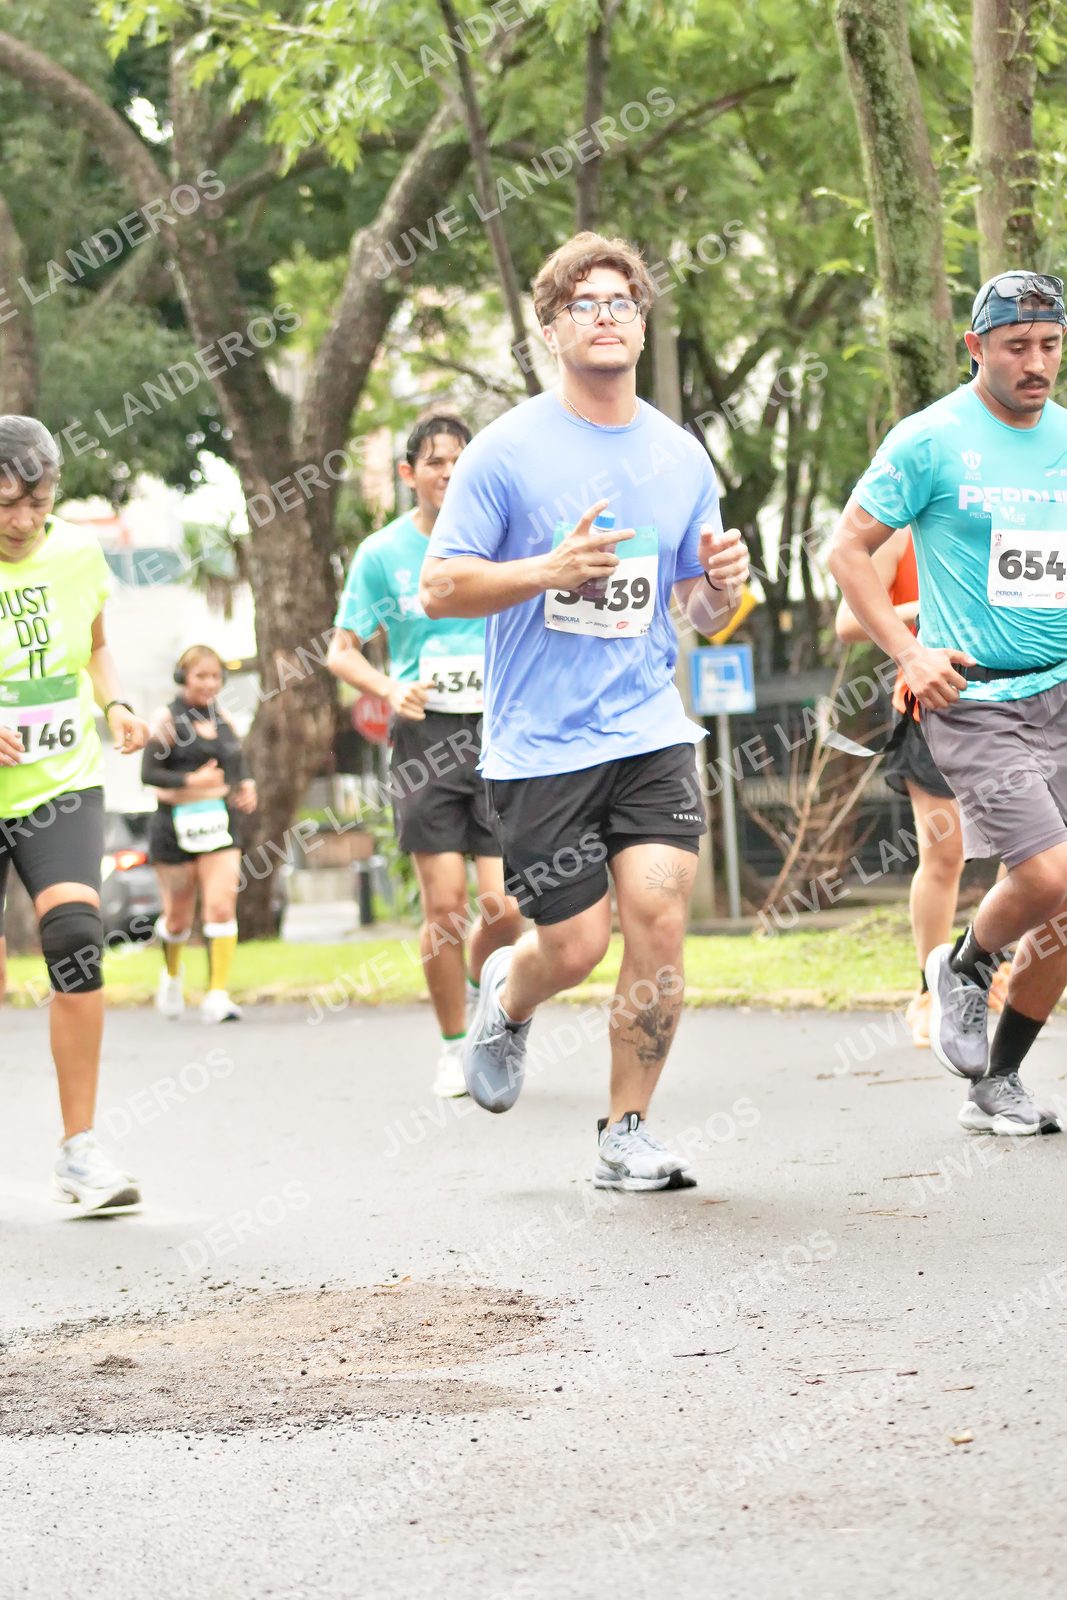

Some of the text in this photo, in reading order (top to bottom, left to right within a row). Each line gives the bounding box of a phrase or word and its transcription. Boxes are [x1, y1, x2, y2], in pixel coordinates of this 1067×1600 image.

[997, 548, 1066, 581] 654
[0, 586, 48, 619] JUST
[15, 617, 50, 648] DO
[552, 614, 580, 624] PERDURA
[29, 648, 49, 679] IT
